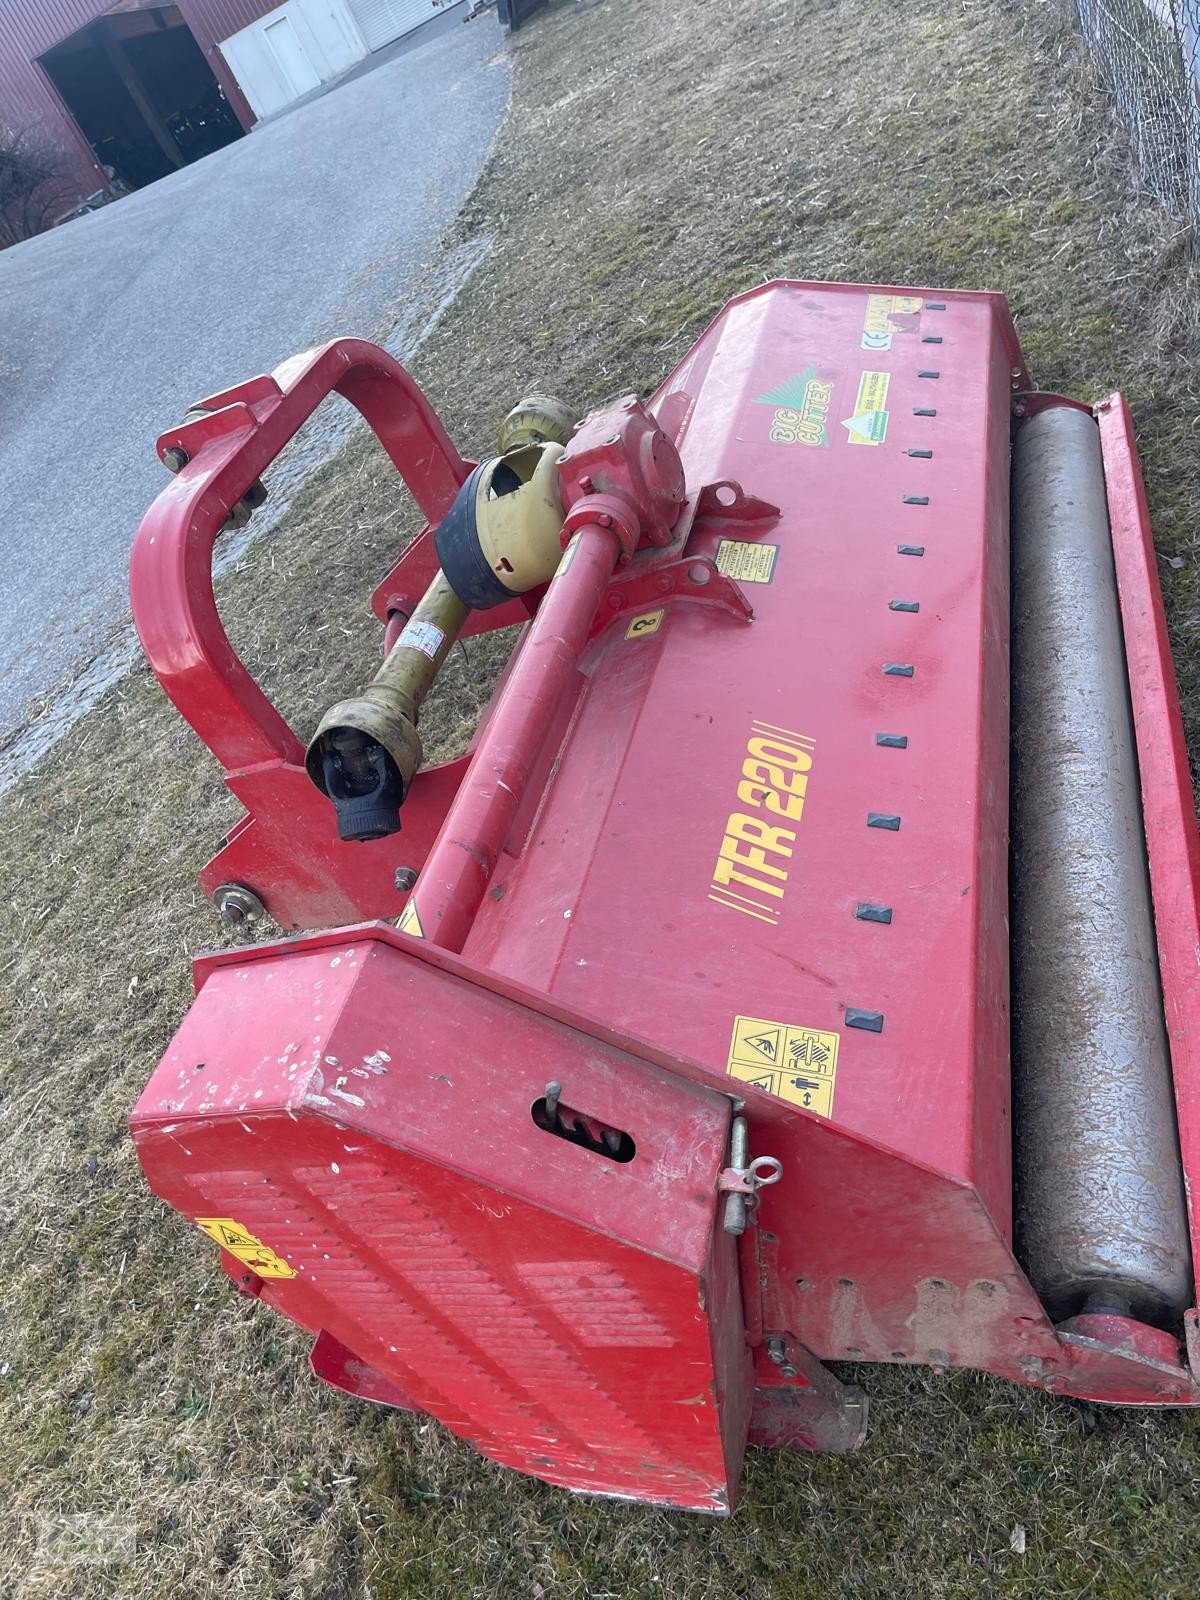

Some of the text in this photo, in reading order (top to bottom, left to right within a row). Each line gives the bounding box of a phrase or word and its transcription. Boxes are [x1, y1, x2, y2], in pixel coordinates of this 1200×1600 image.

[771, 409, 801, 444] BIG
[798, 380, 832, 445] CUTTER
[712, 736, 813, 899] TFR 220
